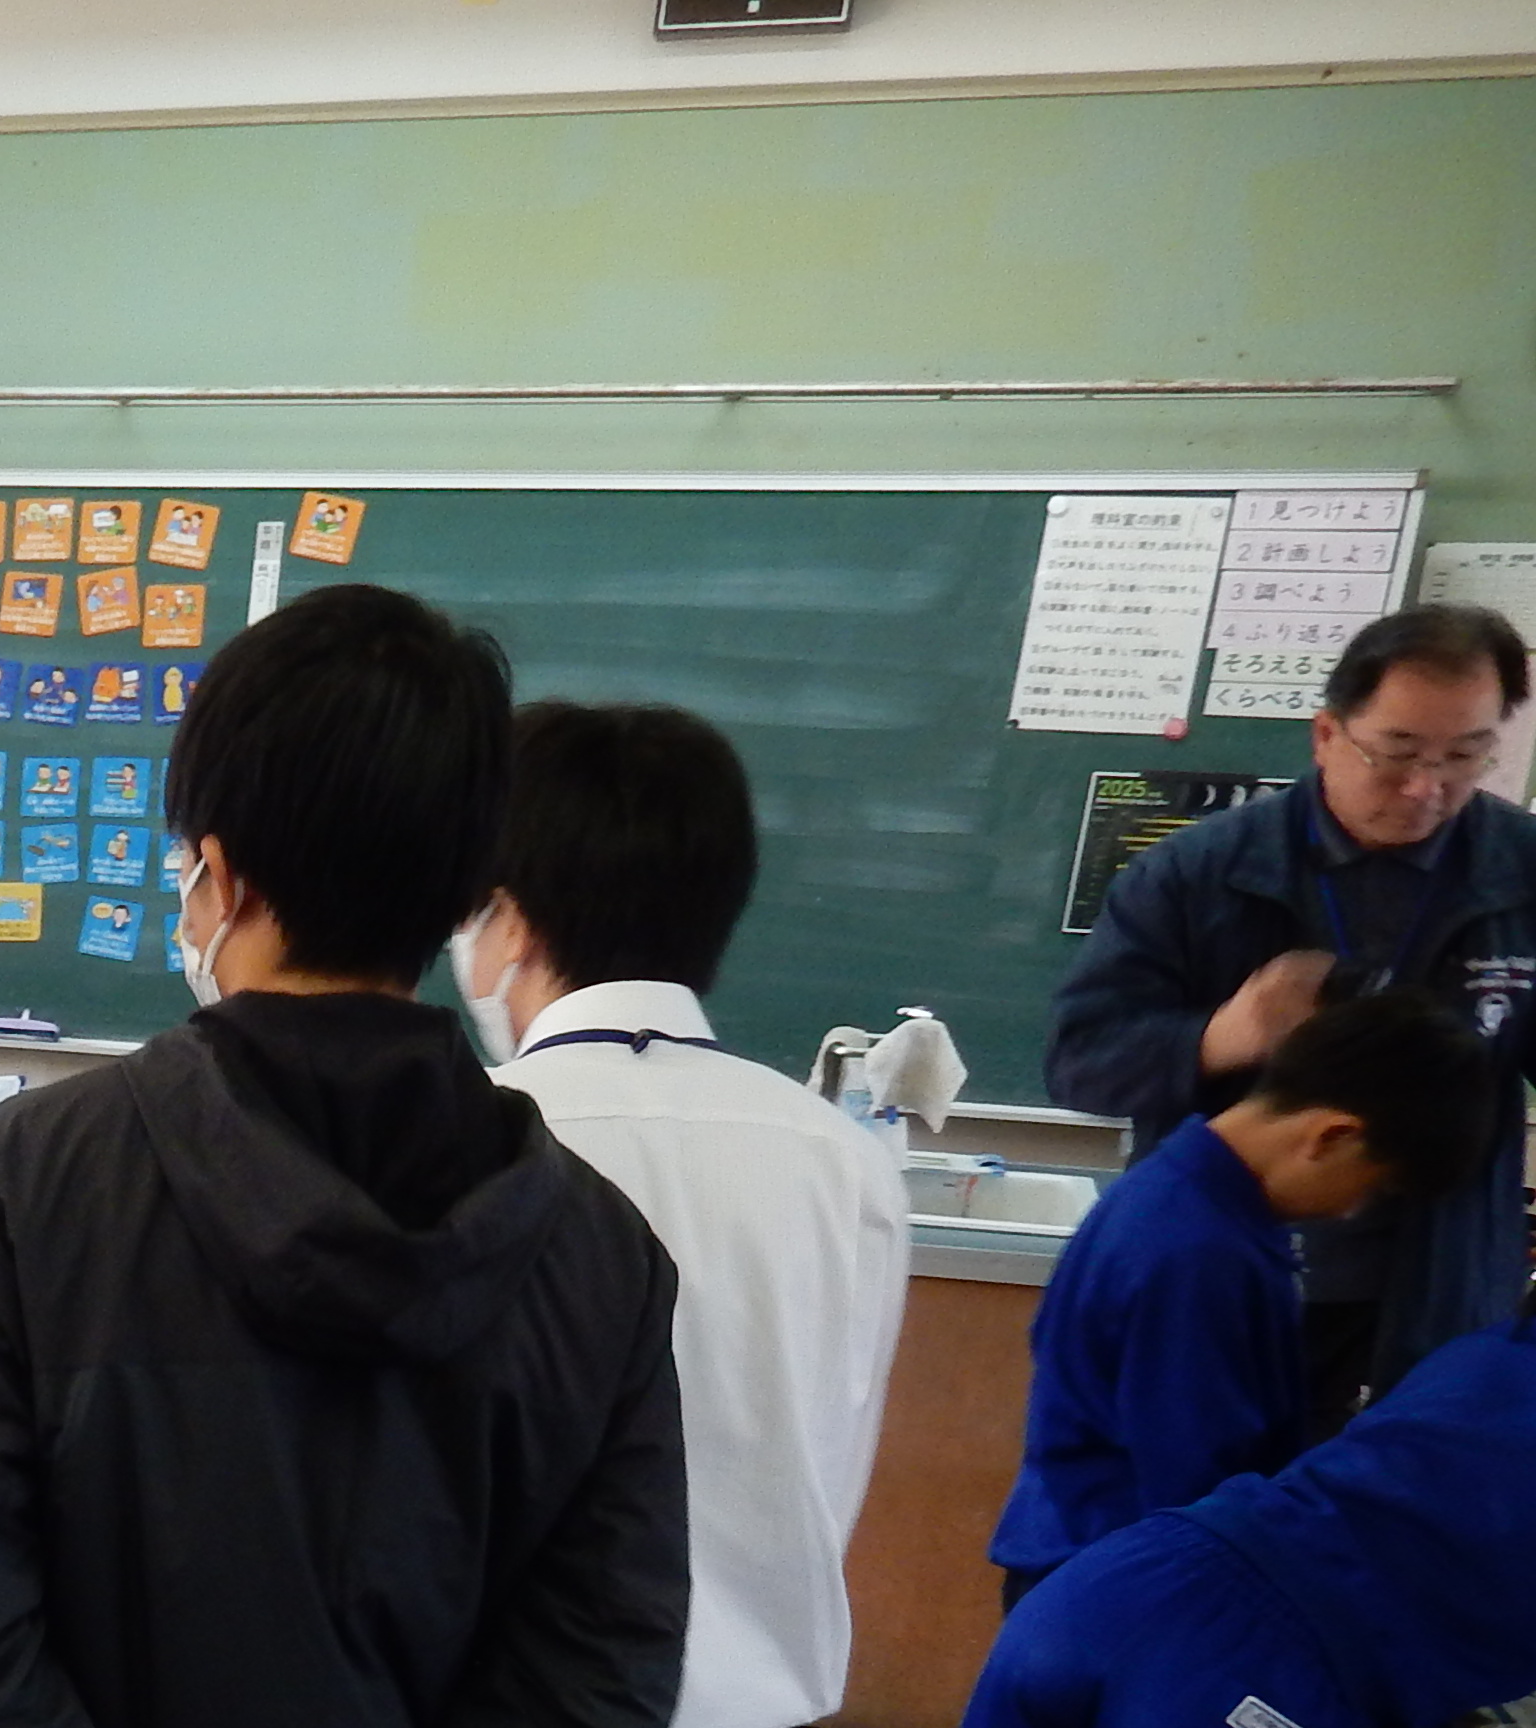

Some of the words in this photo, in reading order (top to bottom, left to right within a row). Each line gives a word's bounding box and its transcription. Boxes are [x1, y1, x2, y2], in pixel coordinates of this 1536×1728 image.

[1237, 543, 1253, 562] 2
[1261, 542, 1387, 564] 計画しよう
[1231, 583, 1246, 601] 3
[1254, 582, 1355, 602] 調べよう
[1097, 780, 1147, 798] 2025
